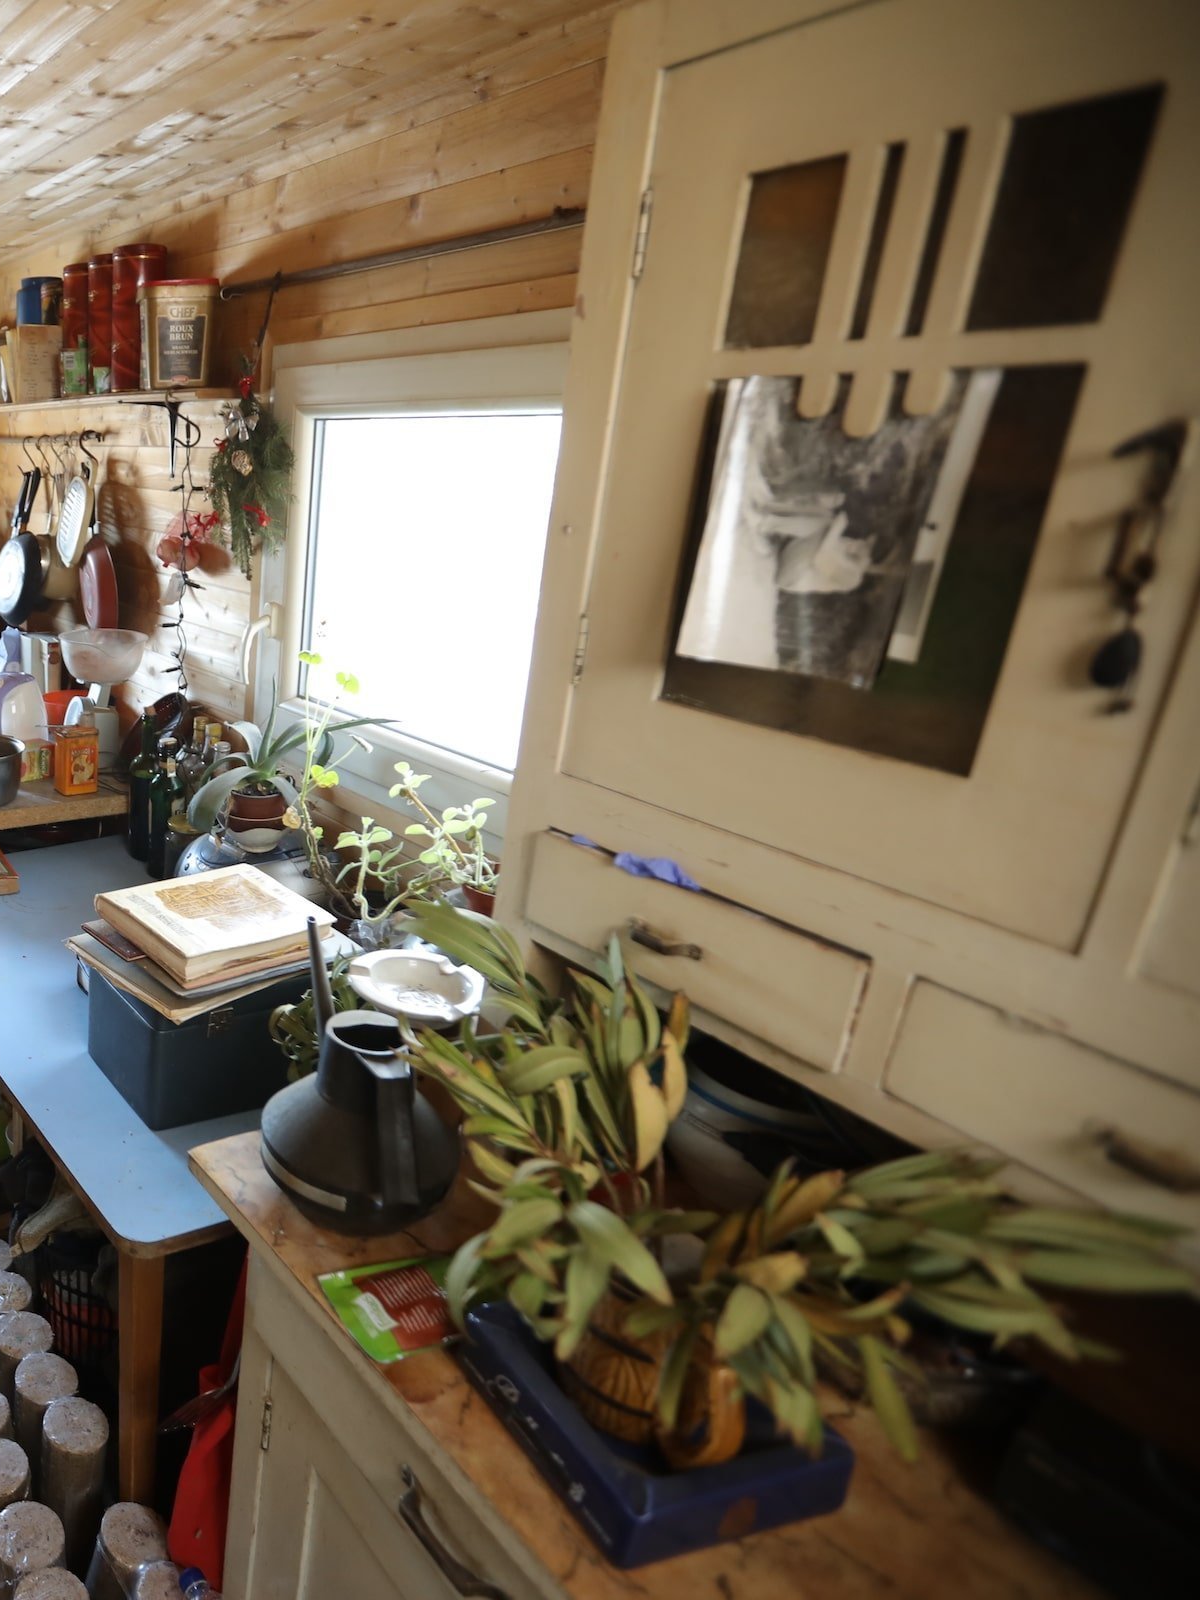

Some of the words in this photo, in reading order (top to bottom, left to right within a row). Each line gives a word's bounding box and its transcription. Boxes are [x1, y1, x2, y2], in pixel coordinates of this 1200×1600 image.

[170, 307, 195, 318] CHEF
[169, 324, 194, 332] ROUX
[169, 333, 193, 341] BRUN
